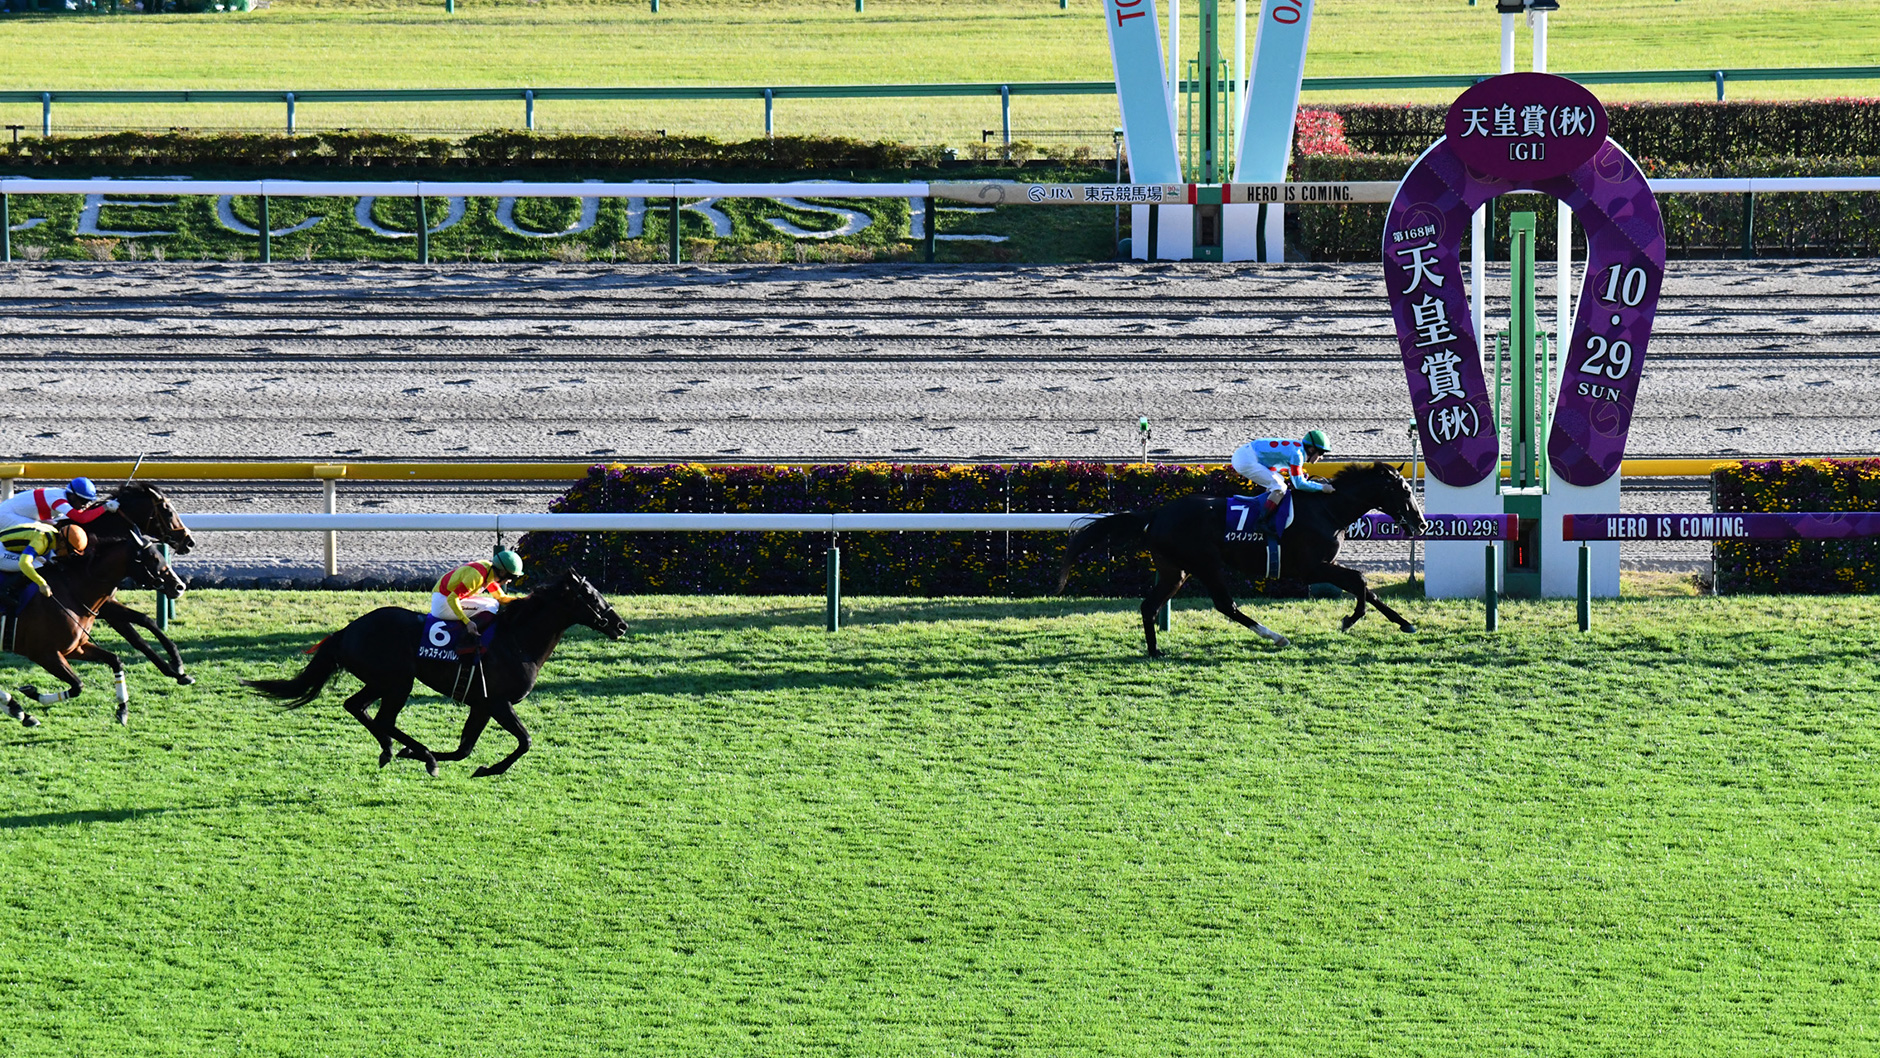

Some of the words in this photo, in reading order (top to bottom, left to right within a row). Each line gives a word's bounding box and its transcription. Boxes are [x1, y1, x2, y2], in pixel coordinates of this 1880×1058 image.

[1272, 0, 1303, 25] O
[1460, 102, 1596, 138] 天皇賞(秋)
[1509, 142, 1545, 161] [GI]
[1048, 188, 1074, 200] JRA
[1085, 186, 1163, 202] 東京競馬場
[1247, 186, 1278, 201] HERO
[1284, 186, 1295, 201] IS
[1301, 186, 1354, 201] COMING.
[1393, 224, 1436, 243] 第168回
[1397, 241, 1480, 445] 天皇賞(秋)
[1577, 382, 1621, 402] SUN
[1230, 505, 1250, 531] 7
[1607, 517, 1648, 538] HERO
[1657, 517, 1672, 538] IS
[1679, 517, 1749, 538] COMING.
[1225, 532, 1264, 541] イクイノックス
[429, 621, 451, 647] 6
[419, 646, 459, 660] ジャスティンパレ
